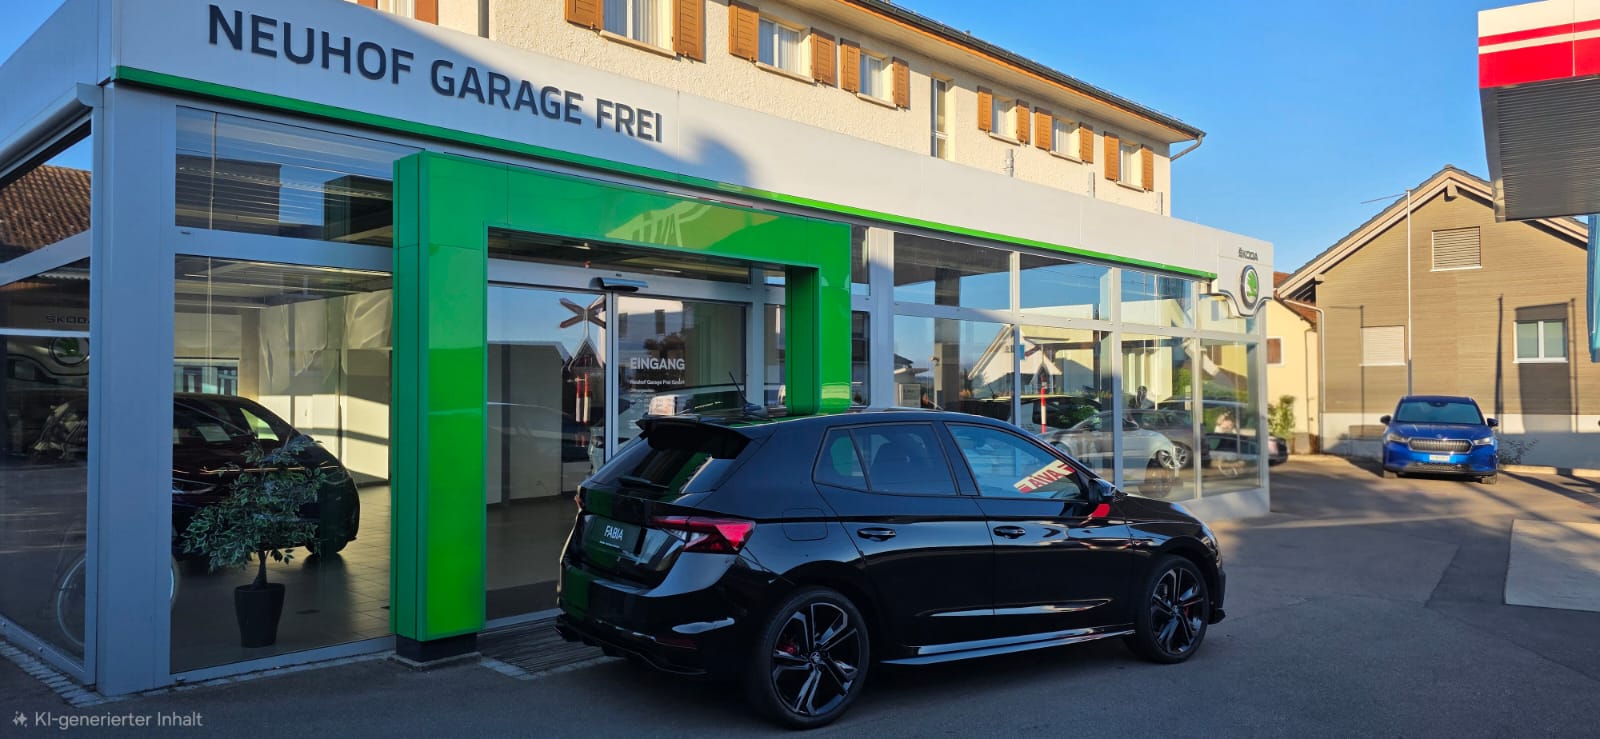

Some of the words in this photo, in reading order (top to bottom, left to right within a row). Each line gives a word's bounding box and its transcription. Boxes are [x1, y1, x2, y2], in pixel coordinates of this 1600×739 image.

[209, 4, 414, 84] NEUHOF
[431, 59, 584, 125] GARAGE
[596, 98, 663, 143] FREI
[630, 357, 685, 370] EINGANG
[604, 525, 624, 541] FABIA
